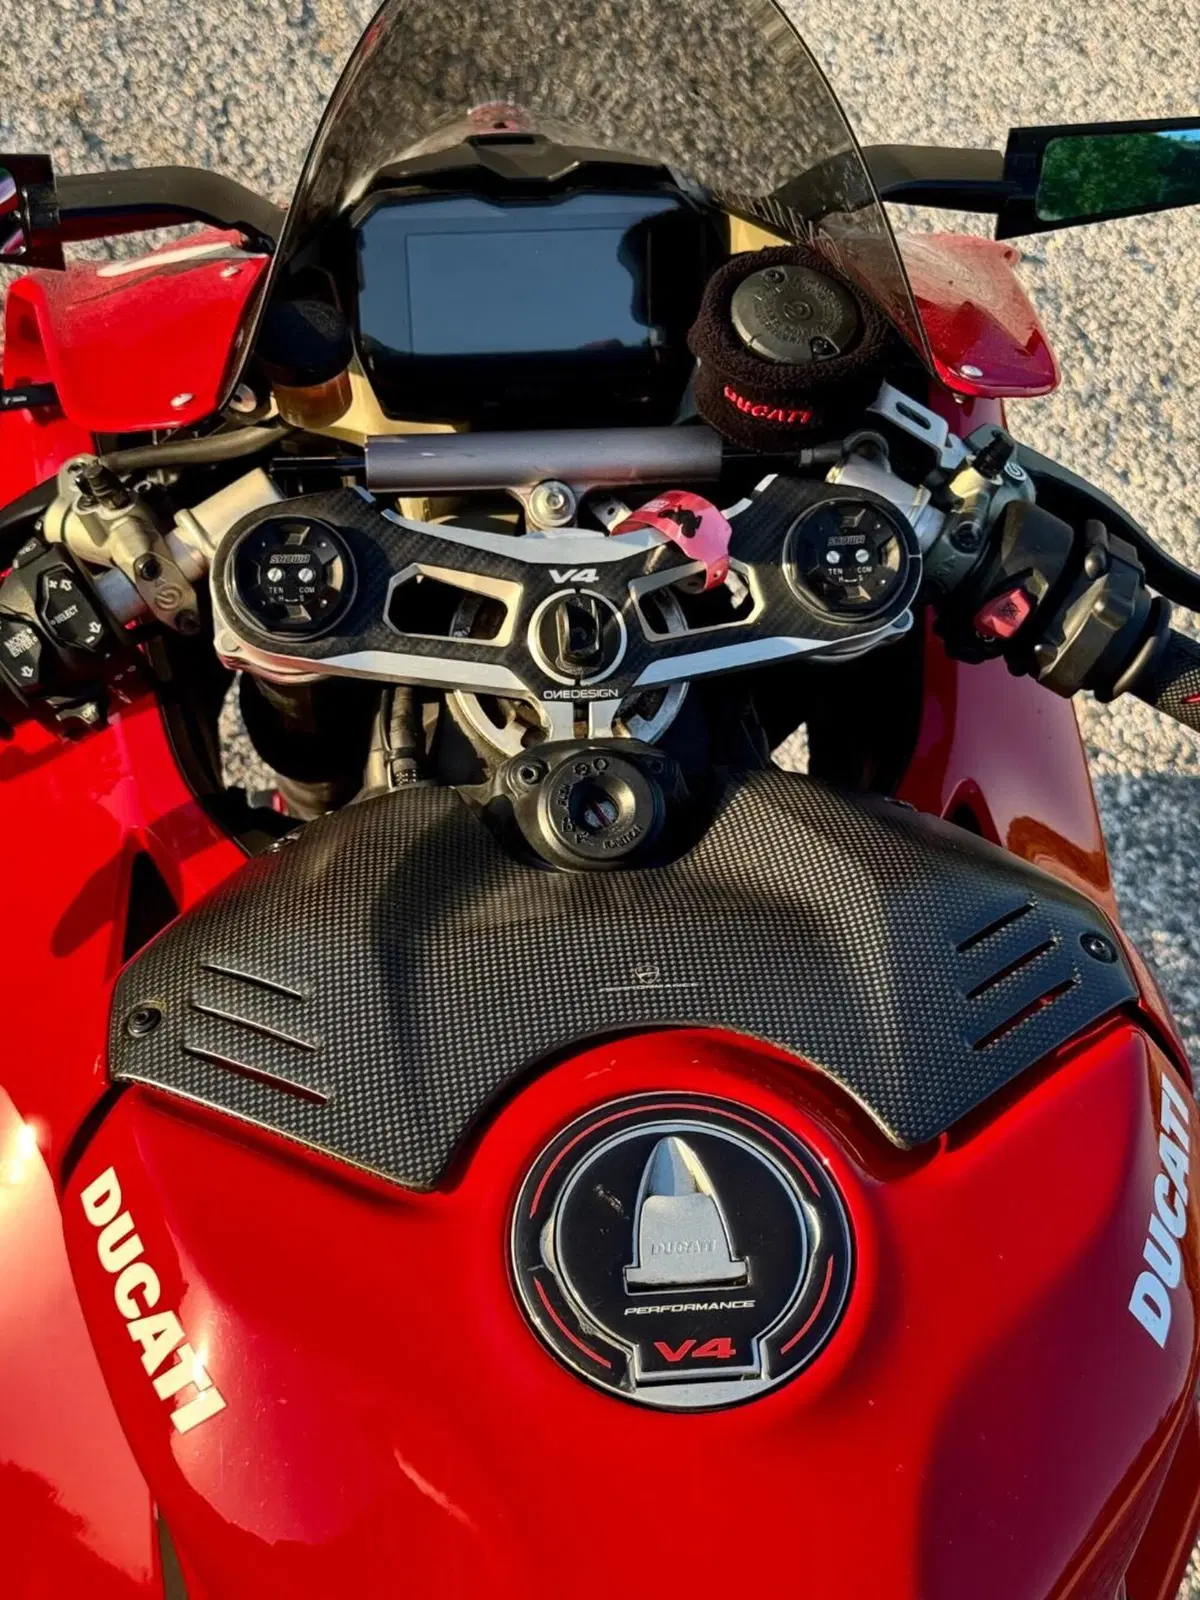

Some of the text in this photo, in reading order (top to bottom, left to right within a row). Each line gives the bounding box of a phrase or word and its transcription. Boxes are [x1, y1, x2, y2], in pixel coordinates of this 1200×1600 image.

[723, 385, 813, 423] DUCATI
[548, 568, 599, 584] V4
[299, 586, 315, 594] COM
[55, 604, 79, 624] SELECT
[1128, 1072, 1189, 1349] DUCATI
[81, 1166, 227, 1435] DUCATI
[624, 1299, 756, 1316] PERFORMANCE
[653, 1337, 737, 1363] V4
